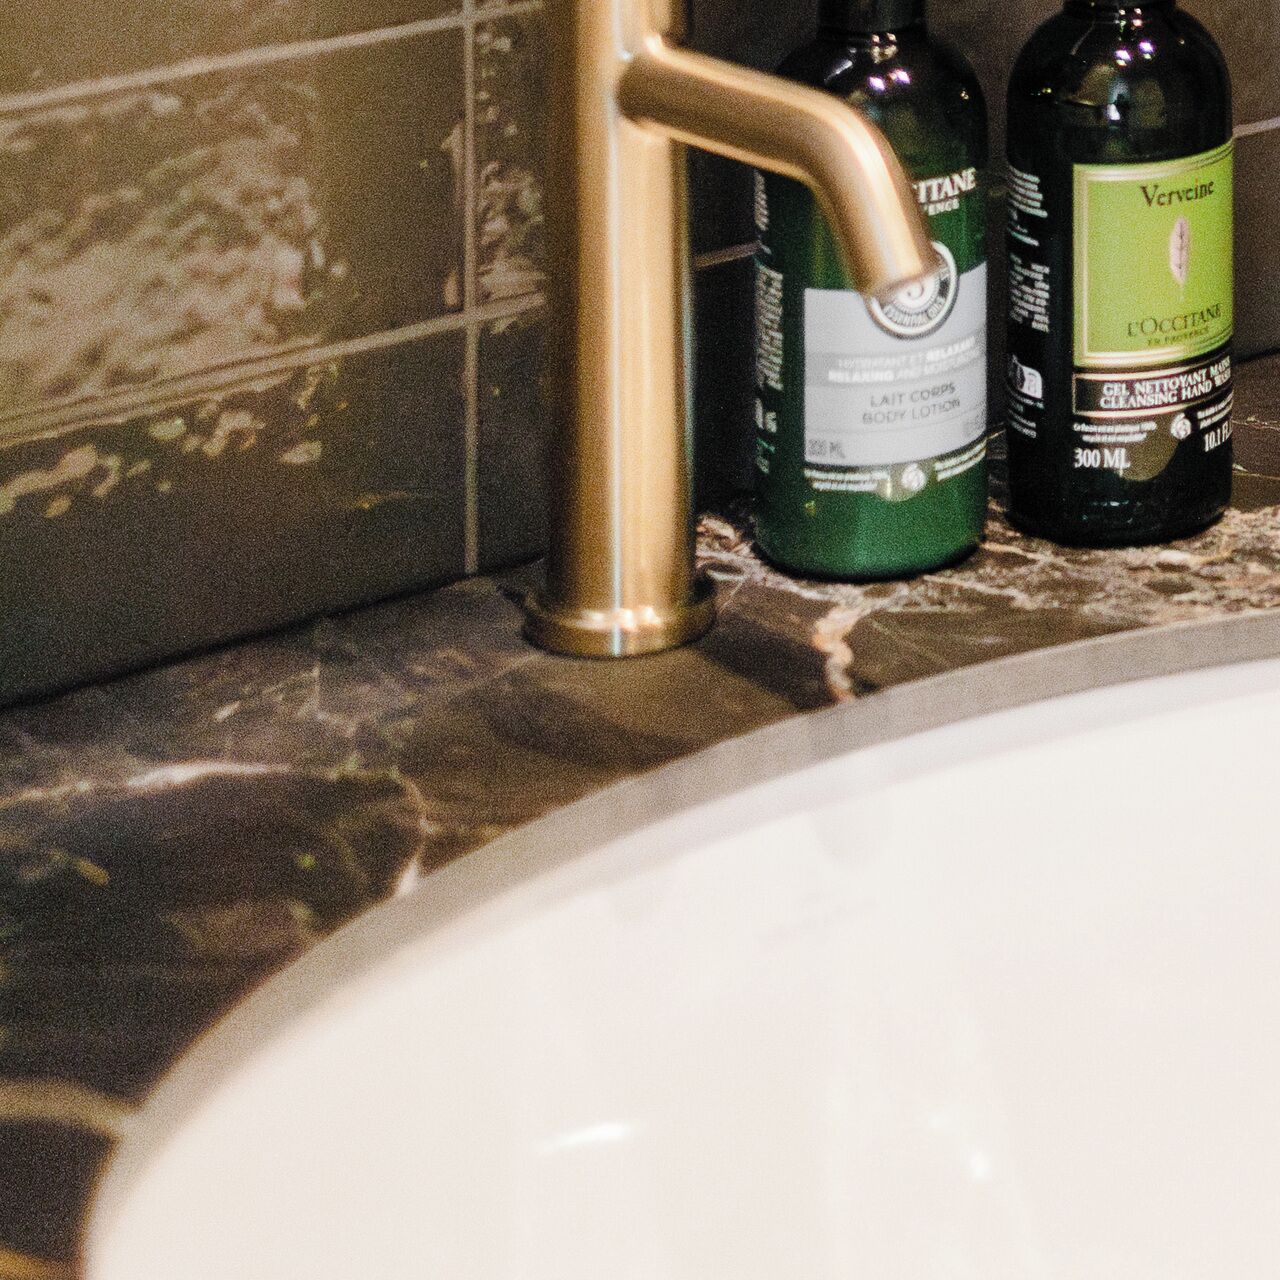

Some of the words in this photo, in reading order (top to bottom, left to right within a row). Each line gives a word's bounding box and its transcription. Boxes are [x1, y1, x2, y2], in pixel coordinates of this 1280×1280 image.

[1140, 177, 1215, 207] Verveine
[1127, 303, 1222, 337] L'OCCITANE
[870, 394, 905, 408] LAIT
[910, 382, 956, 403] CORPS
[1100, 391, 1178, 409] CLEANSING
[1181, 381, 1213, 401] HAND
[1102, 383, 1130, 397] GEL
[1133, 368, 1208, 395] NETTOYANT
[862, 410, 906, 425] BODY
[911, 398, 961, 420] LOTION
[1204, 428, 1221, 452] 10.1
[1074, 447, 1101, 469] 300
[1103, 448, 1131, 469] ML
